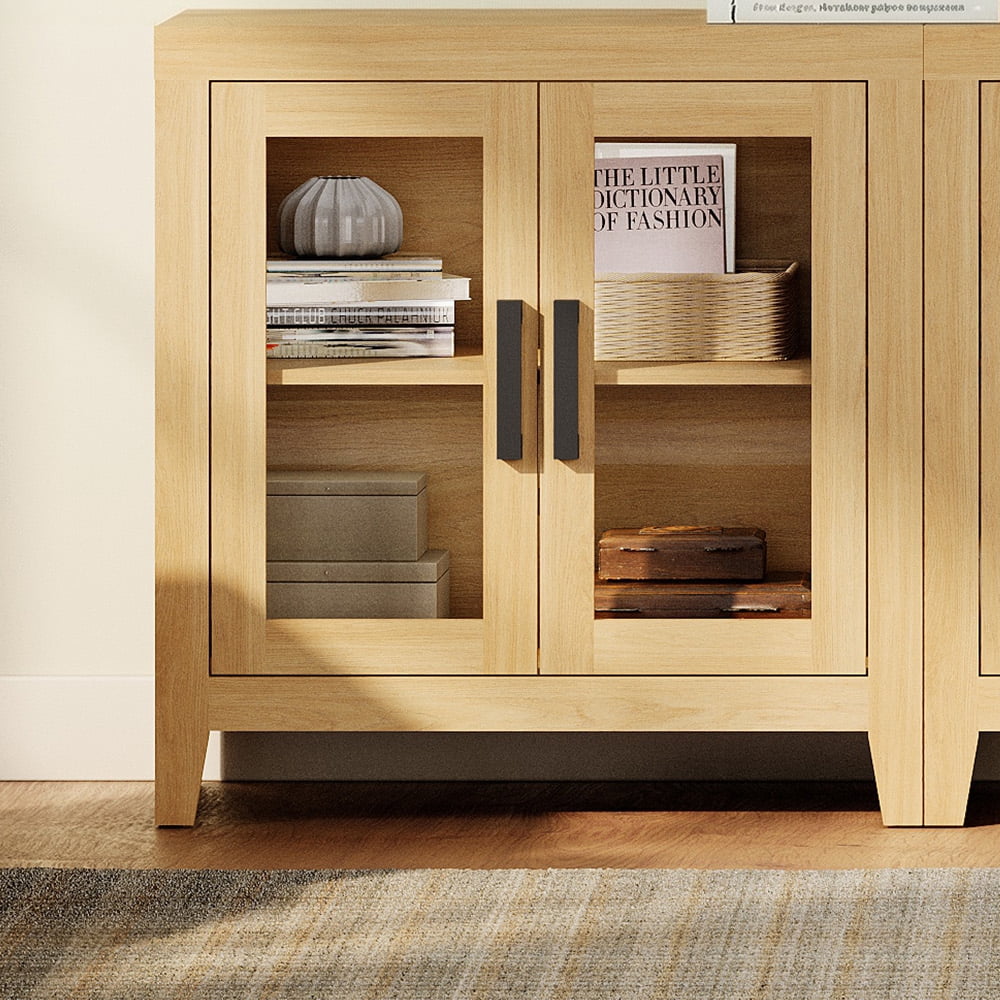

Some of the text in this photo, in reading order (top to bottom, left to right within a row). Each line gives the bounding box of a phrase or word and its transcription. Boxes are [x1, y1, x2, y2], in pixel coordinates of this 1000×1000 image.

[594, 165, 720, 187] THE LITTLE
[594, 186, 722, 209] DICTIONARY
[594, 209, 722, 232] OF FASHION
[293, 307, 326, 324] CLUB
[330, 307, 373, 325] CHUCK
[377, 307, 450, 325] PALAHNIUK
